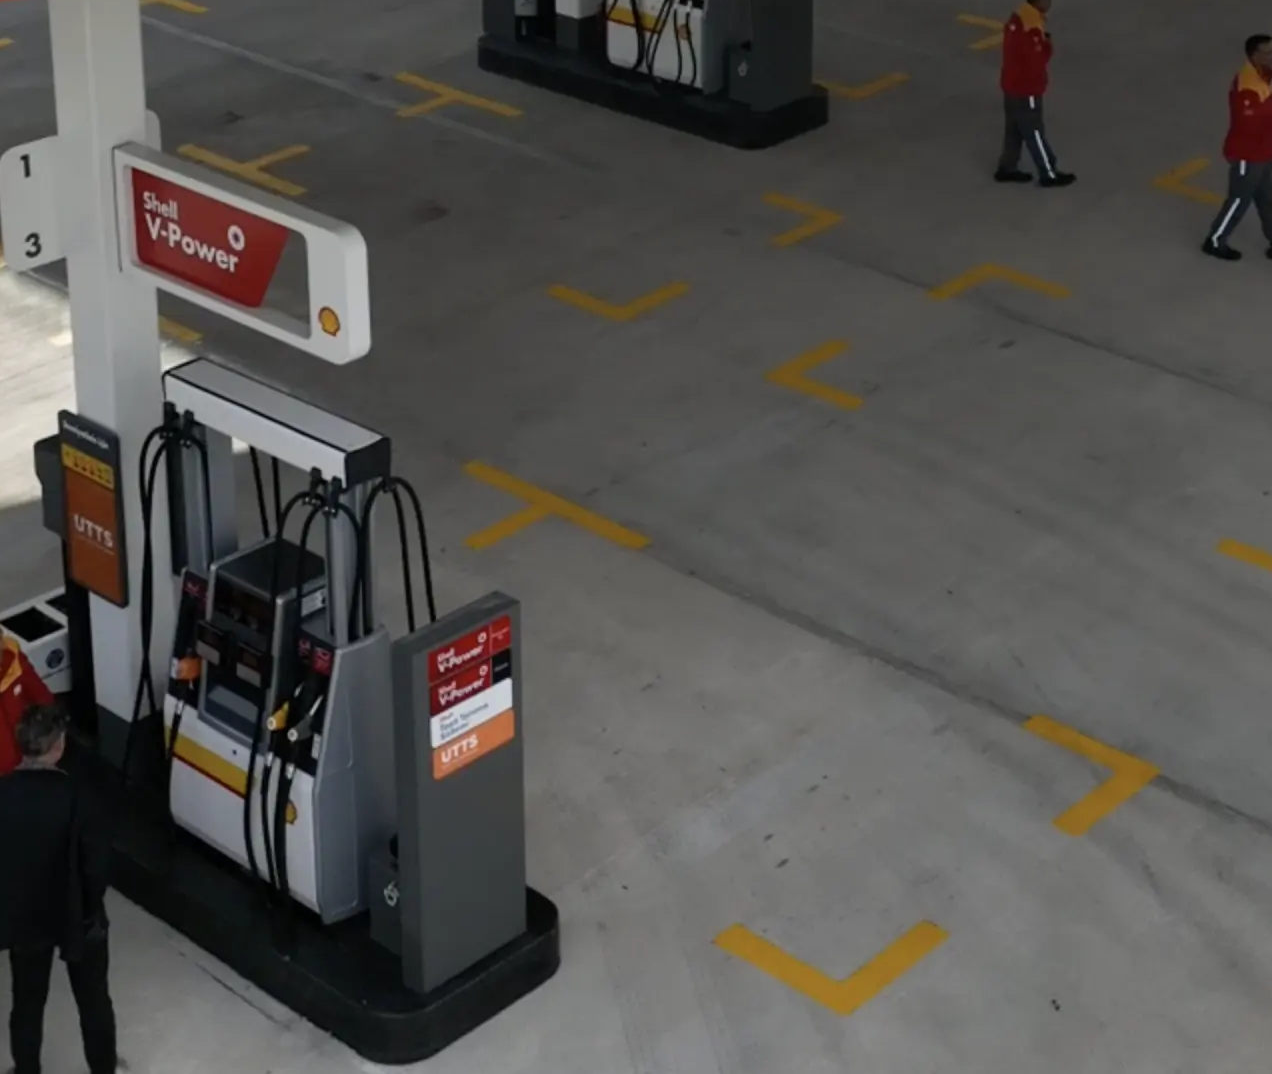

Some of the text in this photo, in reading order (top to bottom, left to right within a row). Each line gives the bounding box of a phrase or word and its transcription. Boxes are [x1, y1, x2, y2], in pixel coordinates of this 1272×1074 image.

[20, 154, 31, 178] 1
[143, 190, 178, 221] Shell
[25, 232, 42, 258] 3
[144, 212, 239, 273] V-Power
[73, 513, 114, 548] UTTS
[441, 734, 479, 764] UTTS
